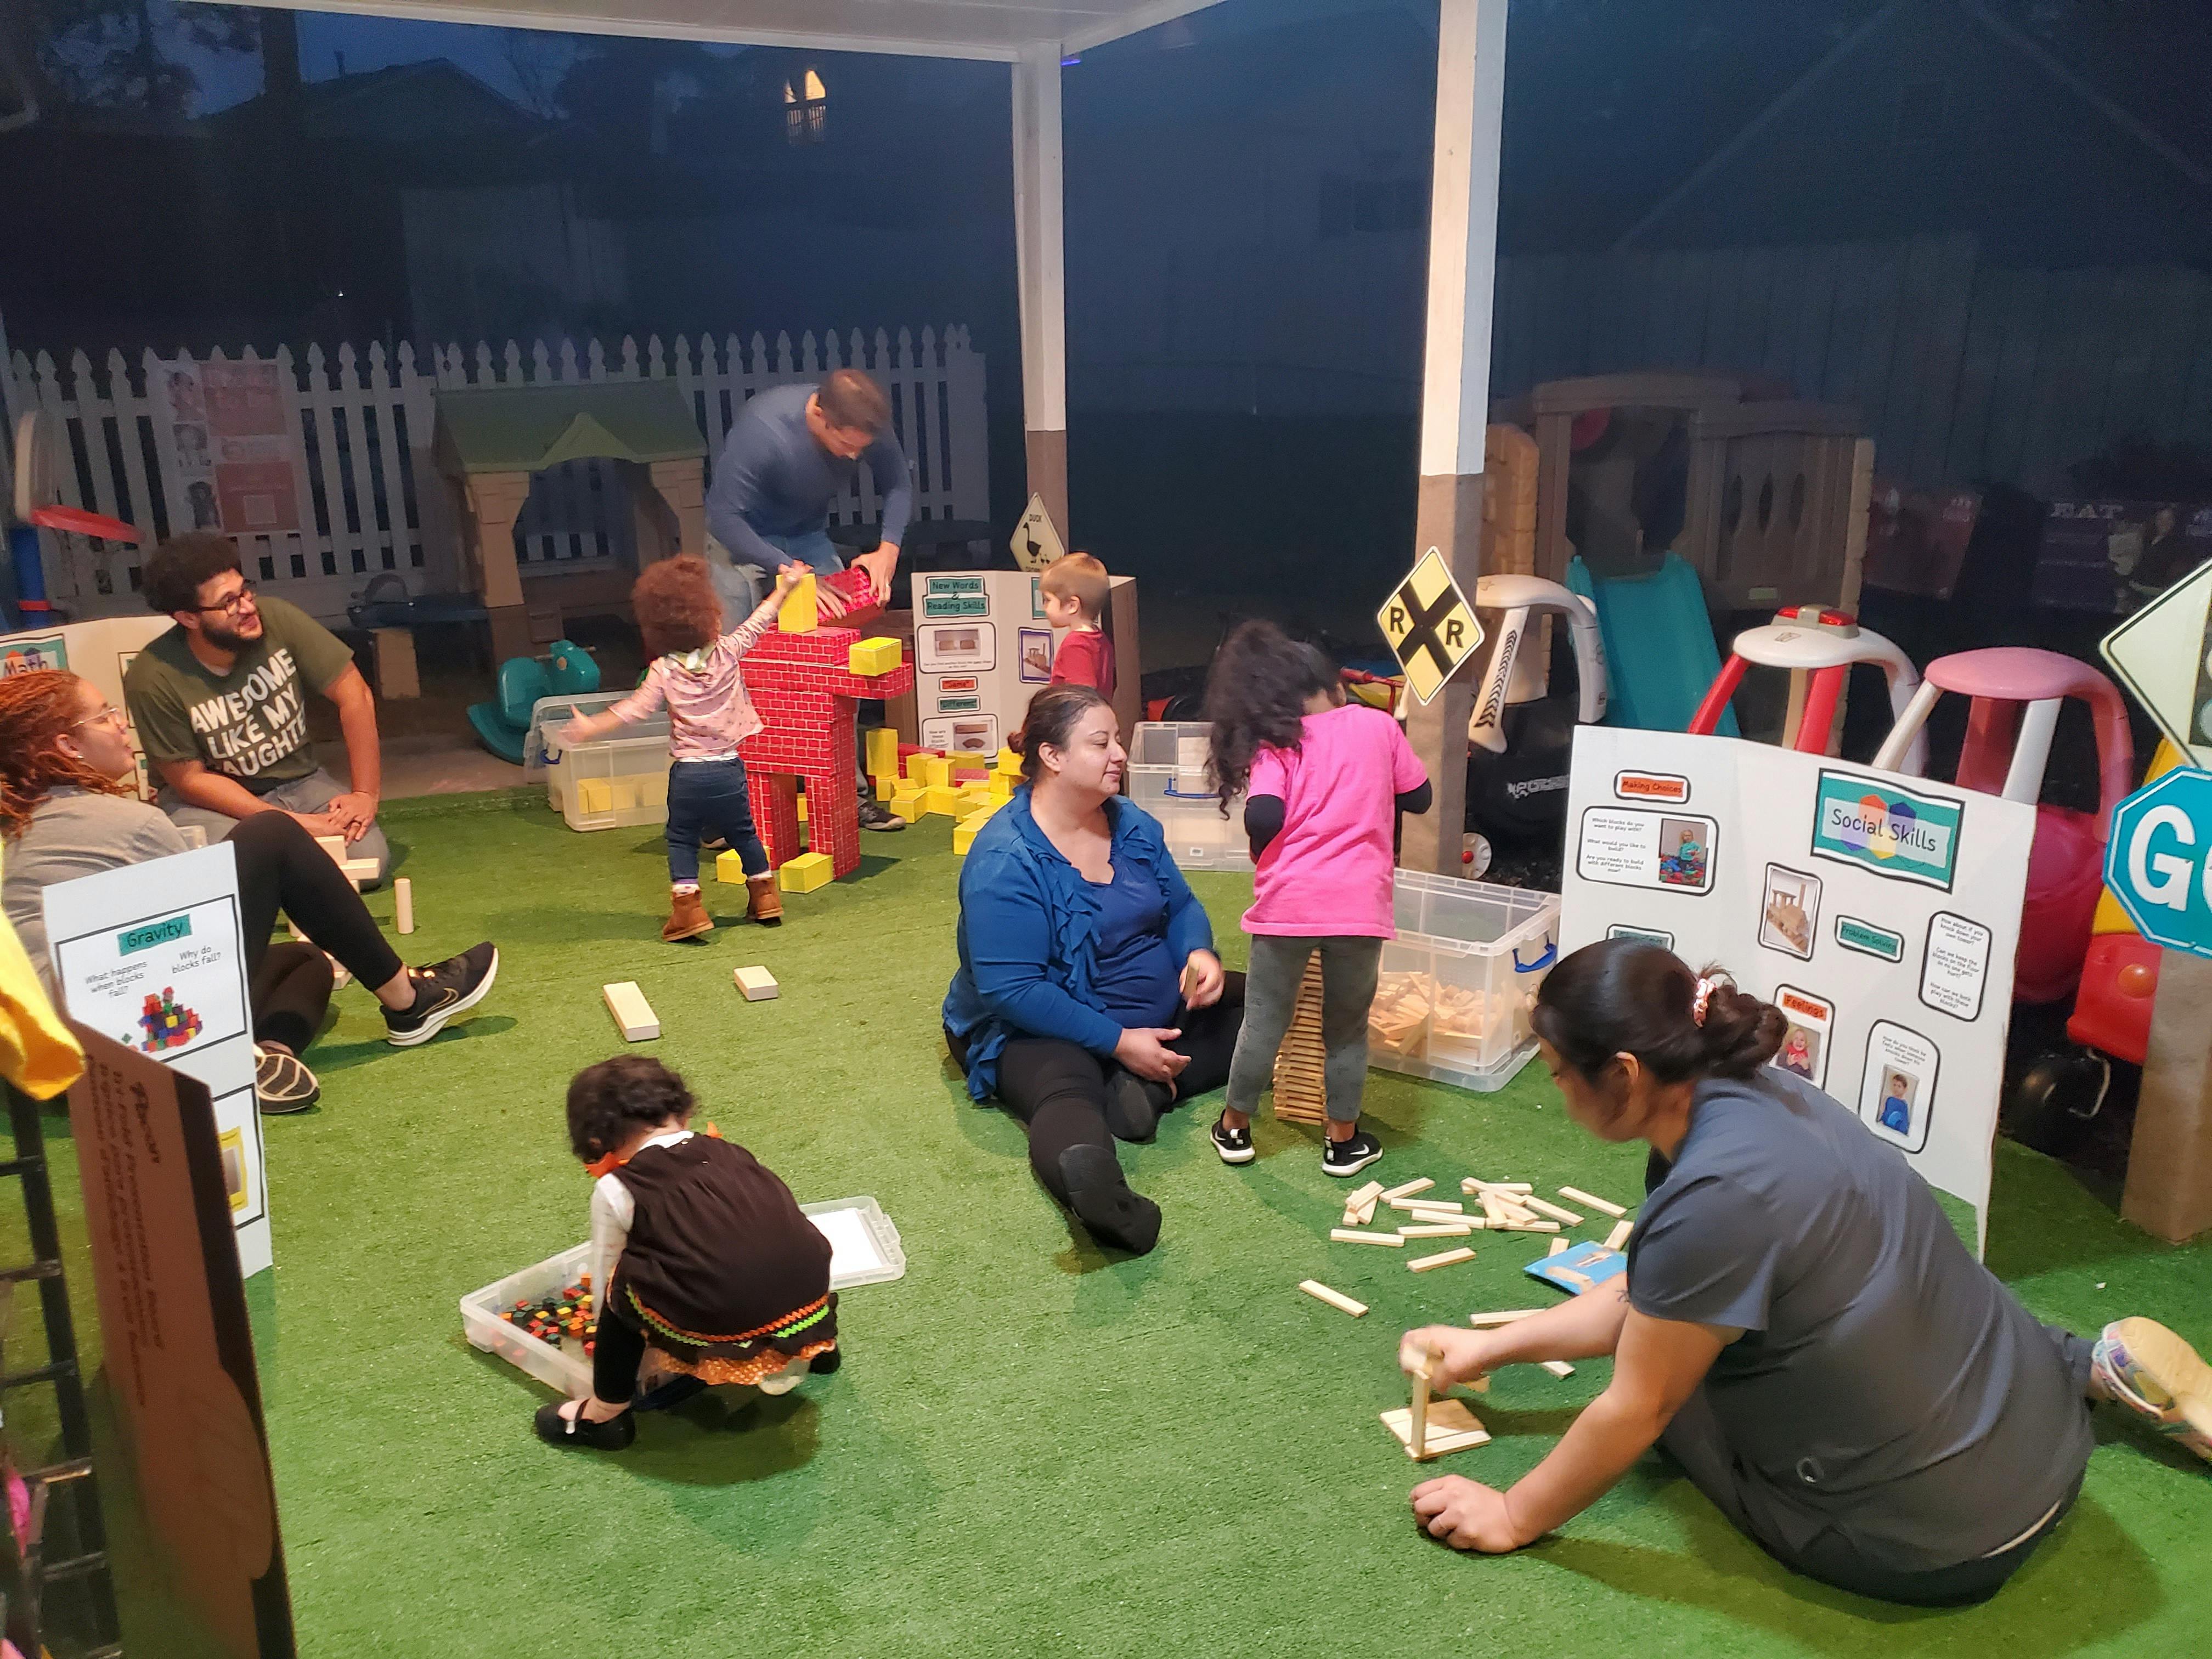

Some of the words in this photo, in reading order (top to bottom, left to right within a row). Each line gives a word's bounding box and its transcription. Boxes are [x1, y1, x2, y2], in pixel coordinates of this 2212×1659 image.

[1029, 514, 1042, 522] DUCK
[952, 581, 979, 589] Words
[927, 602, 961, 612] Reading
[963, 601, 986, 610] Skills
[1390, 607, 1405, 634] R
[1446, 619, 1464, 648] R
[190, 648, 297, 733] AWESOME
[207, 714, 267, 759] LIKE
[262, 682, 299, 730] MY
[223, 701, 306, 776] AUGHTE
[1622, 781, 1650, 792] Making
[1652, 783, 1683, 793] Choices
[1831, 808, 1883, 837] Social
[1889, 823, 1936, 851] Skills
[2128, 804, 2212, 915] G
[127, 922, 183, 947] Gravity
[1842, 926, 1869, 940] Problem
[1872, 935, 1897, 953] Solving
[172, 958, 200, 974] blocks
[201, 952, 222, 964] fall?
[179, 949, 198, 961] Why
[201, 945, 211, 954] do
[86, 973, 109, 984] What
[110, 961, 148, 977] happens
[91, 981, 114, 993] when
[116, 972, 144, 985] blocks
[109, 985, 129, 998] fall?
[1786, 995, 1824, 1018] Feelings
